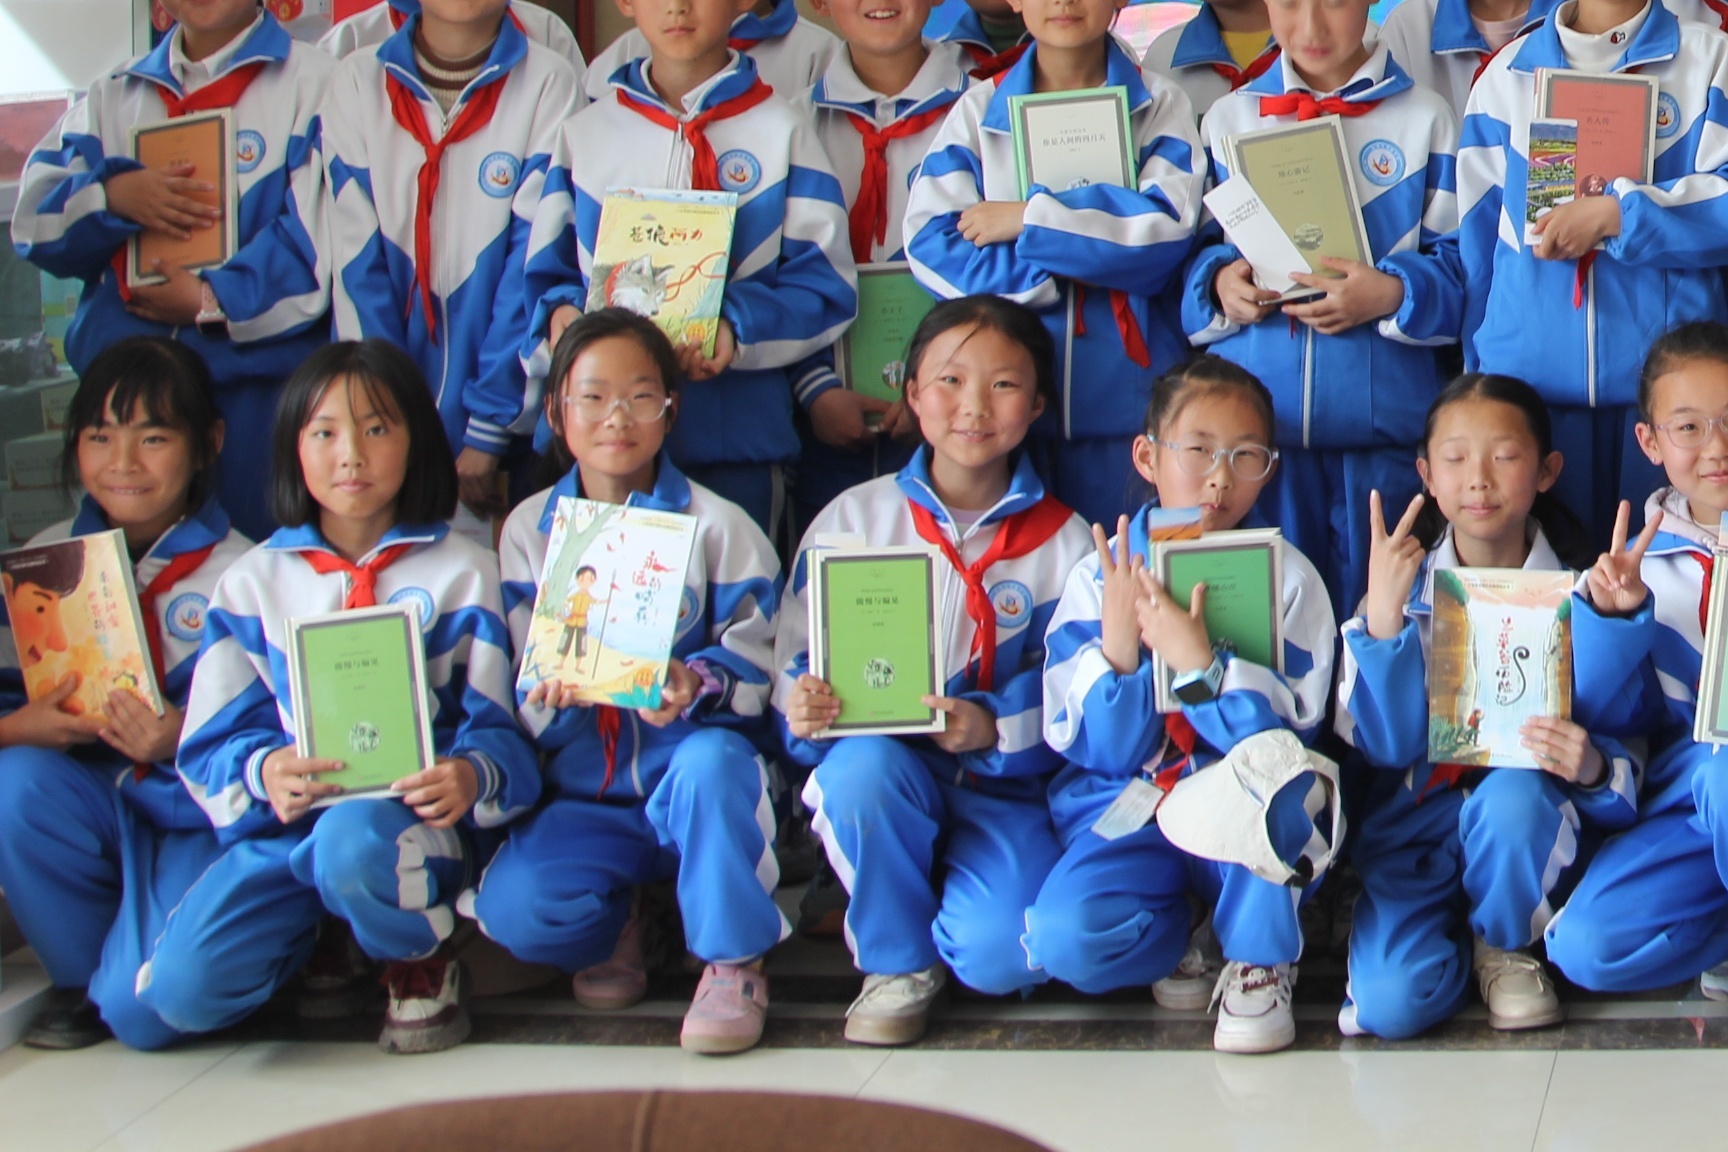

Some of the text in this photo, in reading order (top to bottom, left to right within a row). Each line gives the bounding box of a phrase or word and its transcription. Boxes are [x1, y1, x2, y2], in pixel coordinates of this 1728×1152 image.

[1043, 134, 1106, 146] 你是人间的四月天
